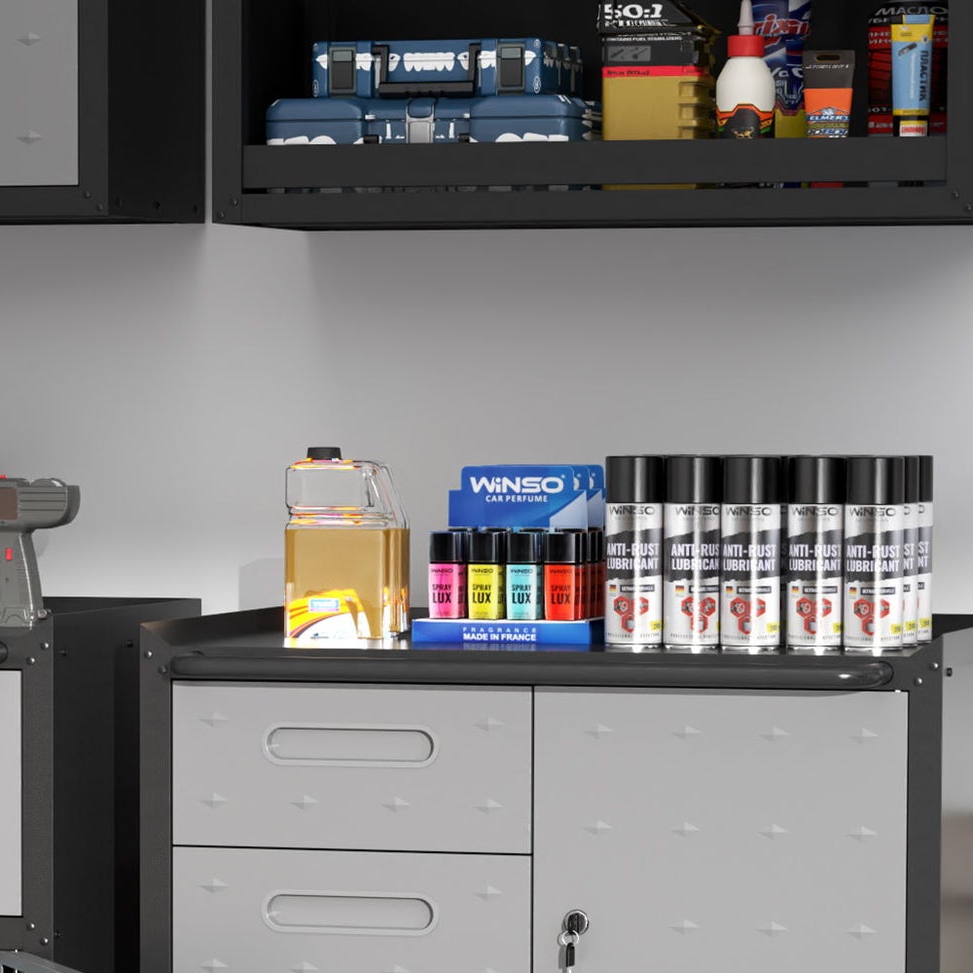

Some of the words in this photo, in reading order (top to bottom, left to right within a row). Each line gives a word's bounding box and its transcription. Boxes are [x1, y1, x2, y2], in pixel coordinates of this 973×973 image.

[607, 543, 659, 556] ANTI-RUST
[723, 543, 776, 557] ANTI-RUST
[789, 543, 842, 557] ANTI-RUST
[846, 544, 900, 558] ANTI-RUST
[607, 557, 659, 570] LUBRICANT
[723, 558, 775, 571] LUBRICANT
[789, 558, 841, 571] LUBRICANT
[847, 559, 900, 572] LUBRICANT
[432, 592, 451, 603] LUX
[472, 592, 491, 603] LUX
[512, 593, 531, 604] LUX
[551, 593, 571, 604] LUX
[501, 633, 536, 641] FRANCE
